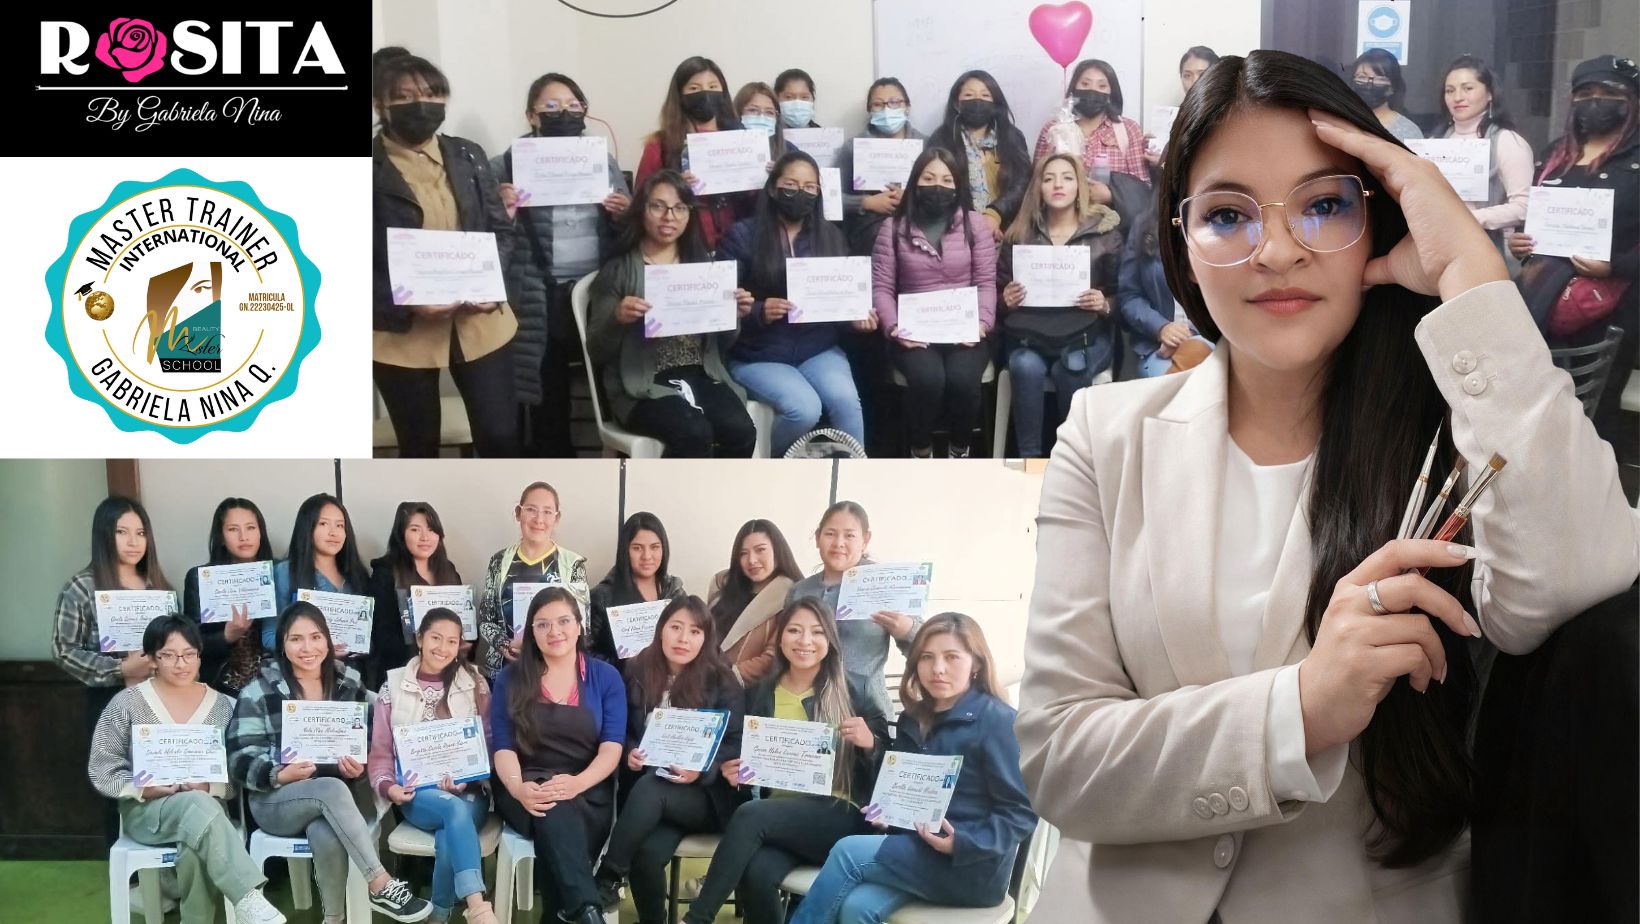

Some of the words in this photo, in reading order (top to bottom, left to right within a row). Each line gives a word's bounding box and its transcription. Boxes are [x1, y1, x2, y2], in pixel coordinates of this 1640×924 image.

[414, 250, 477, 260] CERTIFICADO
[765, 735, 811, 747] CERTIFICADO
[899, 770, 940, 782] CERTIFICADO
